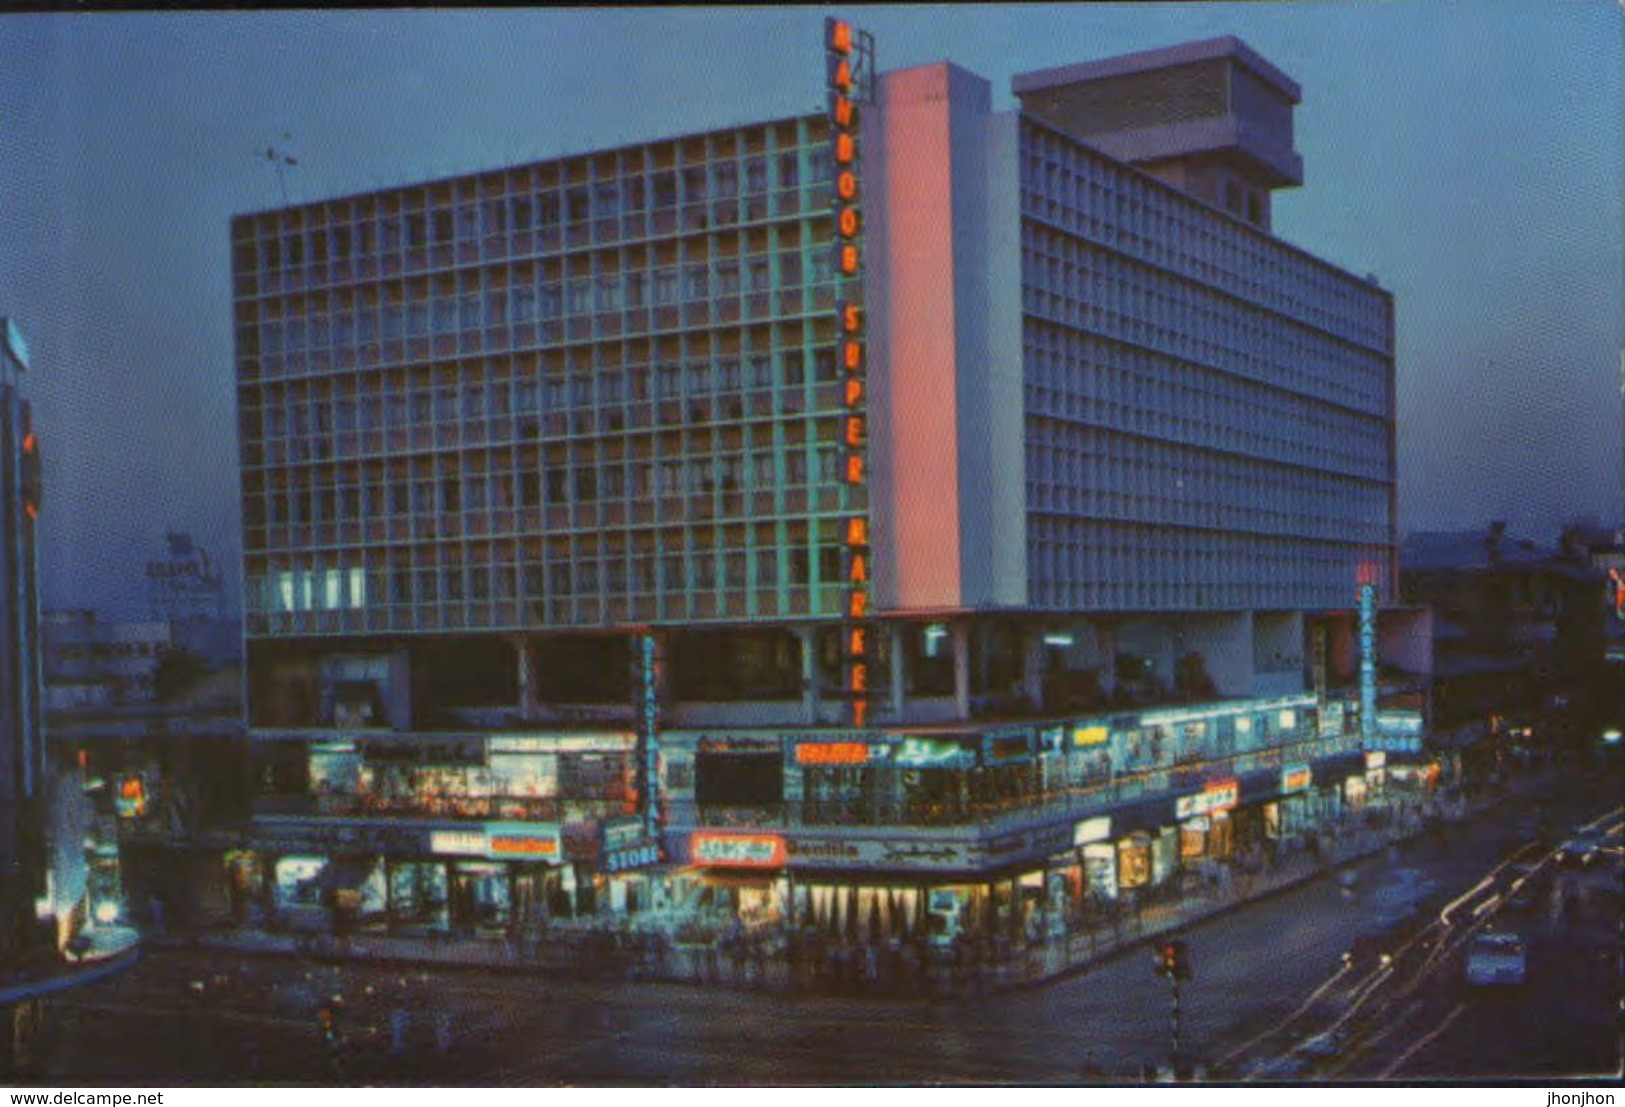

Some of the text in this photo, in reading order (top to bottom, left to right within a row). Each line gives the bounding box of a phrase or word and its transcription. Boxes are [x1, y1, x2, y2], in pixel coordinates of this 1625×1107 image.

[844, 304, 863, 485] SUPER
[847, 517, 867, 728] MARKET
[607, 845, 659, 872] STORE
